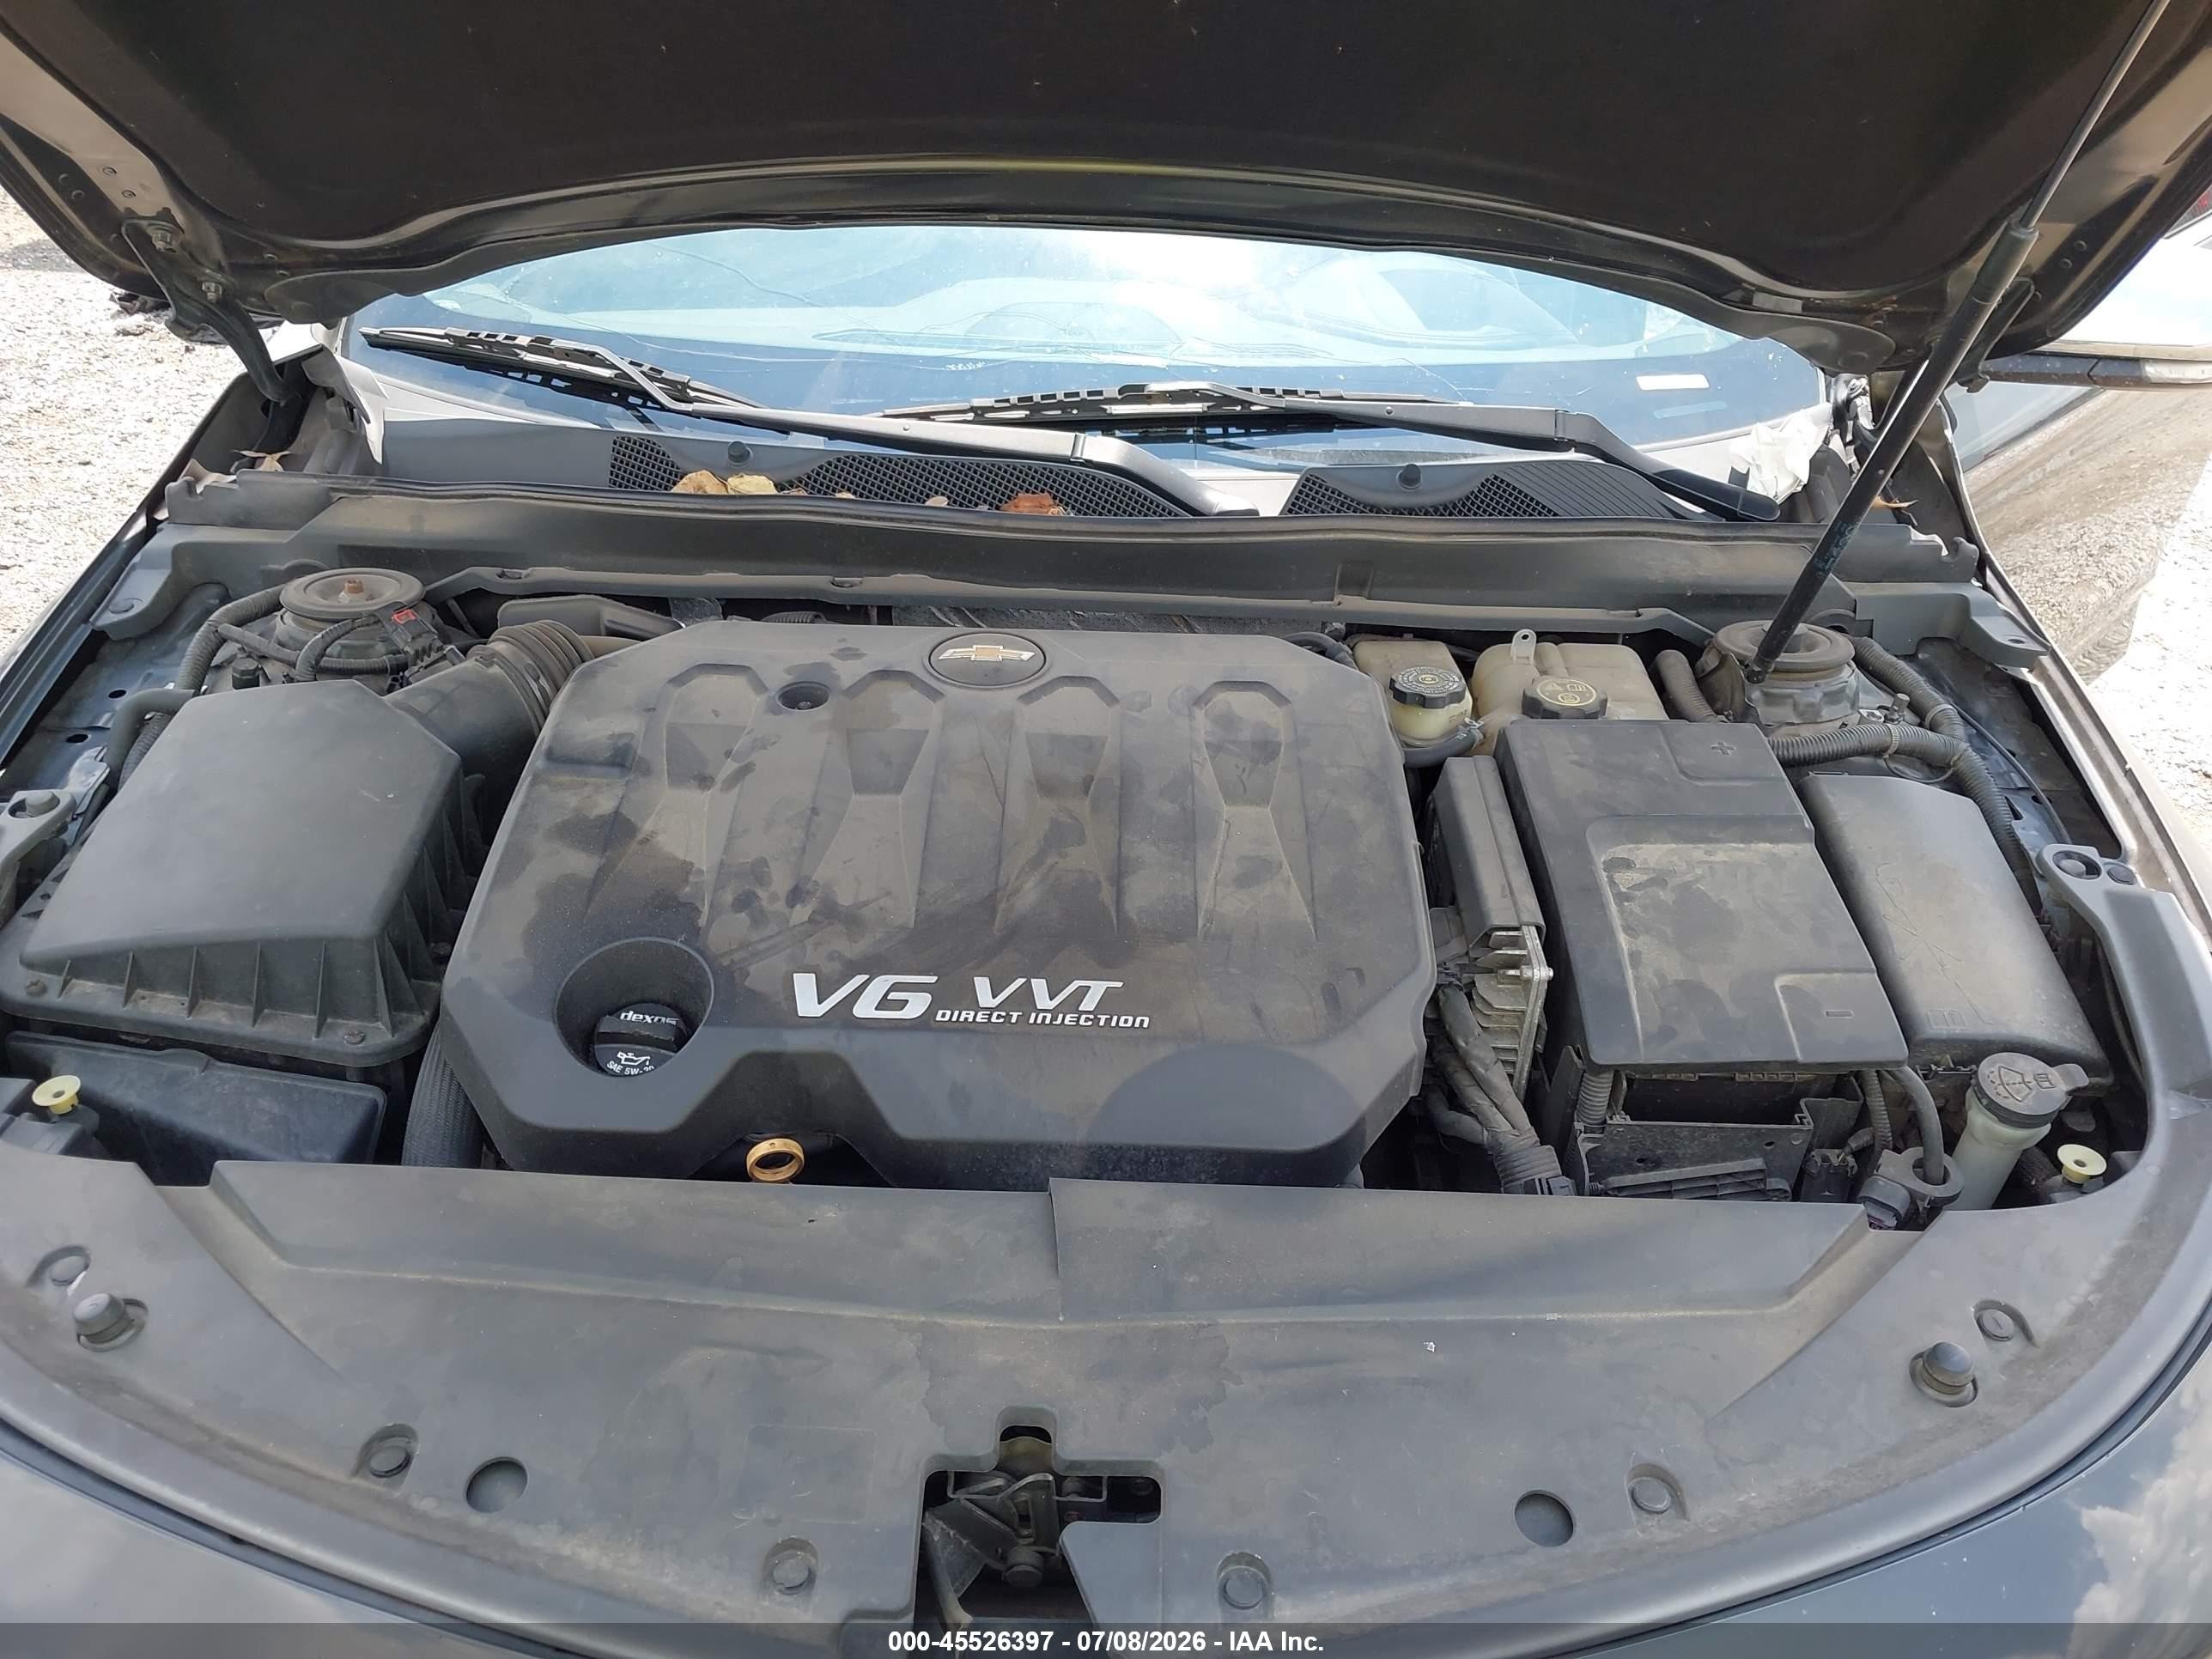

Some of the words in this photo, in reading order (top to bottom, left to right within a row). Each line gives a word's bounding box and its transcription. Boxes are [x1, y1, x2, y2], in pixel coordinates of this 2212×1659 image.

[793, 973, 939, 1019] V6
[973, 976, 1124, 1012] VVT
[935, 1010, 1022, 1024] DIRECT
[1029, 1012, 1150, 1029] INJECTION
[606, 1060, 623, 1073] SAE
